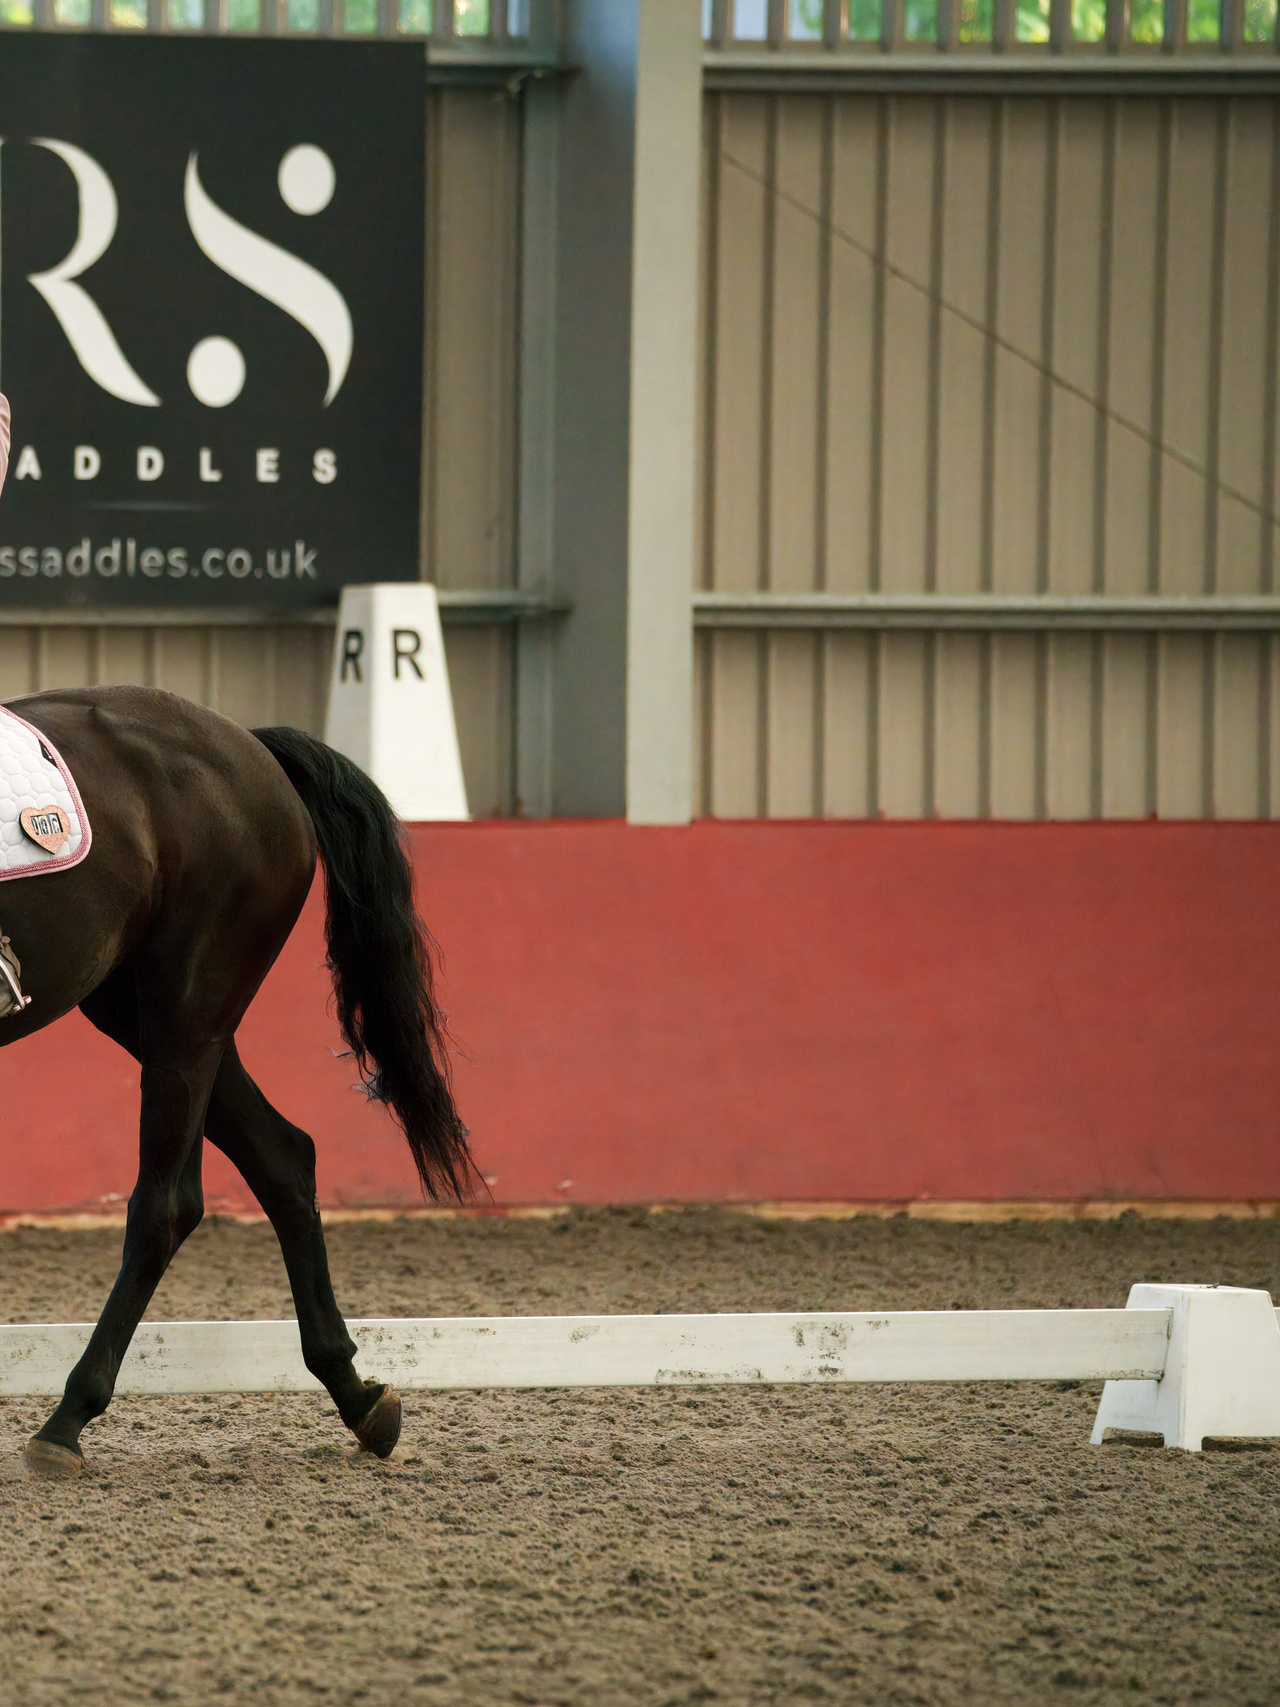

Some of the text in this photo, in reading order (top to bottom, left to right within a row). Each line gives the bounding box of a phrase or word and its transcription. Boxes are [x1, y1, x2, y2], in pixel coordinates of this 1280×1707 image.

[14, 444, 338, 485] ADDLES
[340, 629, 365, 684] R
[391, 628, 425, 681] R
